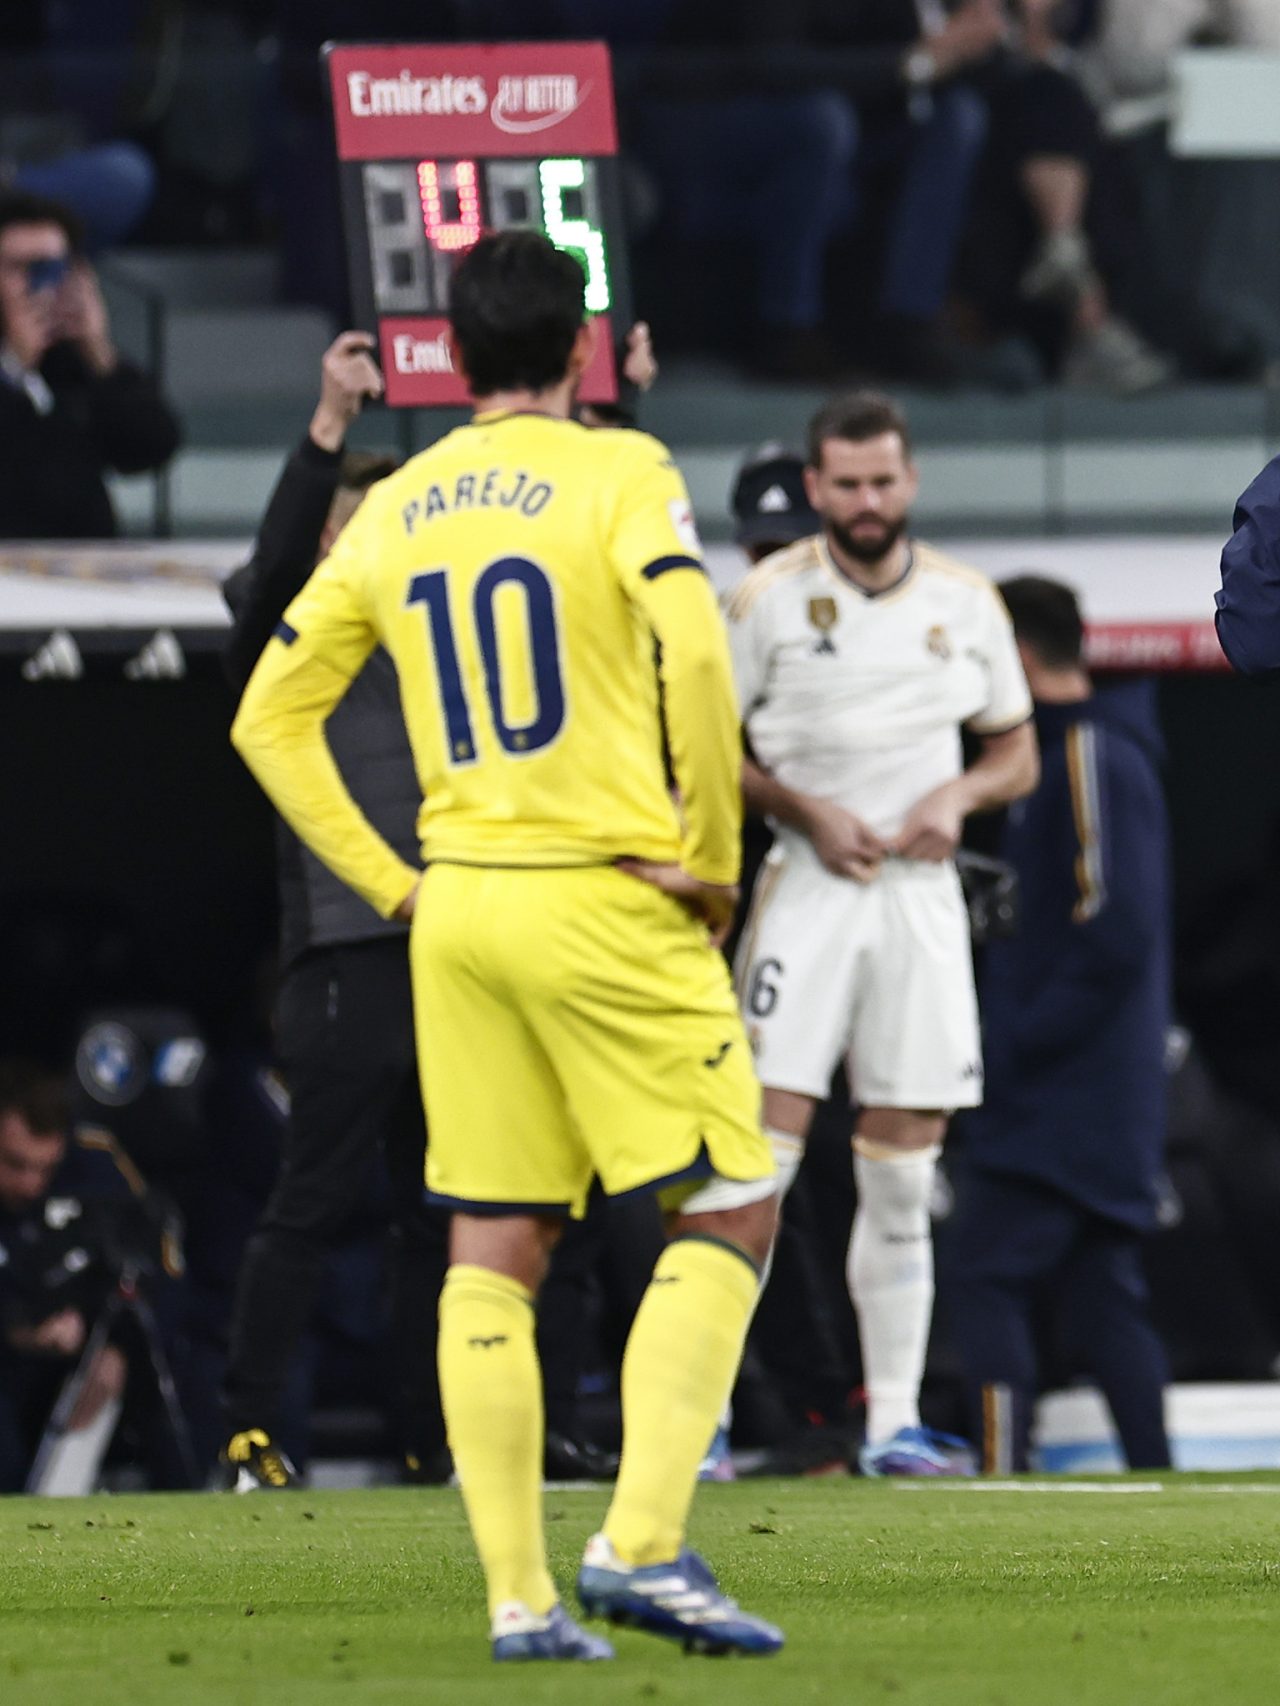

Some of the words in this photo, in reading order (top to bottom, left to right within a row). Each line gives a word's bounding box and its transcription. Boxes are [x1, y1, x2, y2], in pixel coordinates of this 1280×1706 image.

[347, 70, 487, 116] Emirates
[402, 469, 552, 534] PAREJO
[406, 556, 567, 764] 10
[750, 957, 783, 1017] 6
